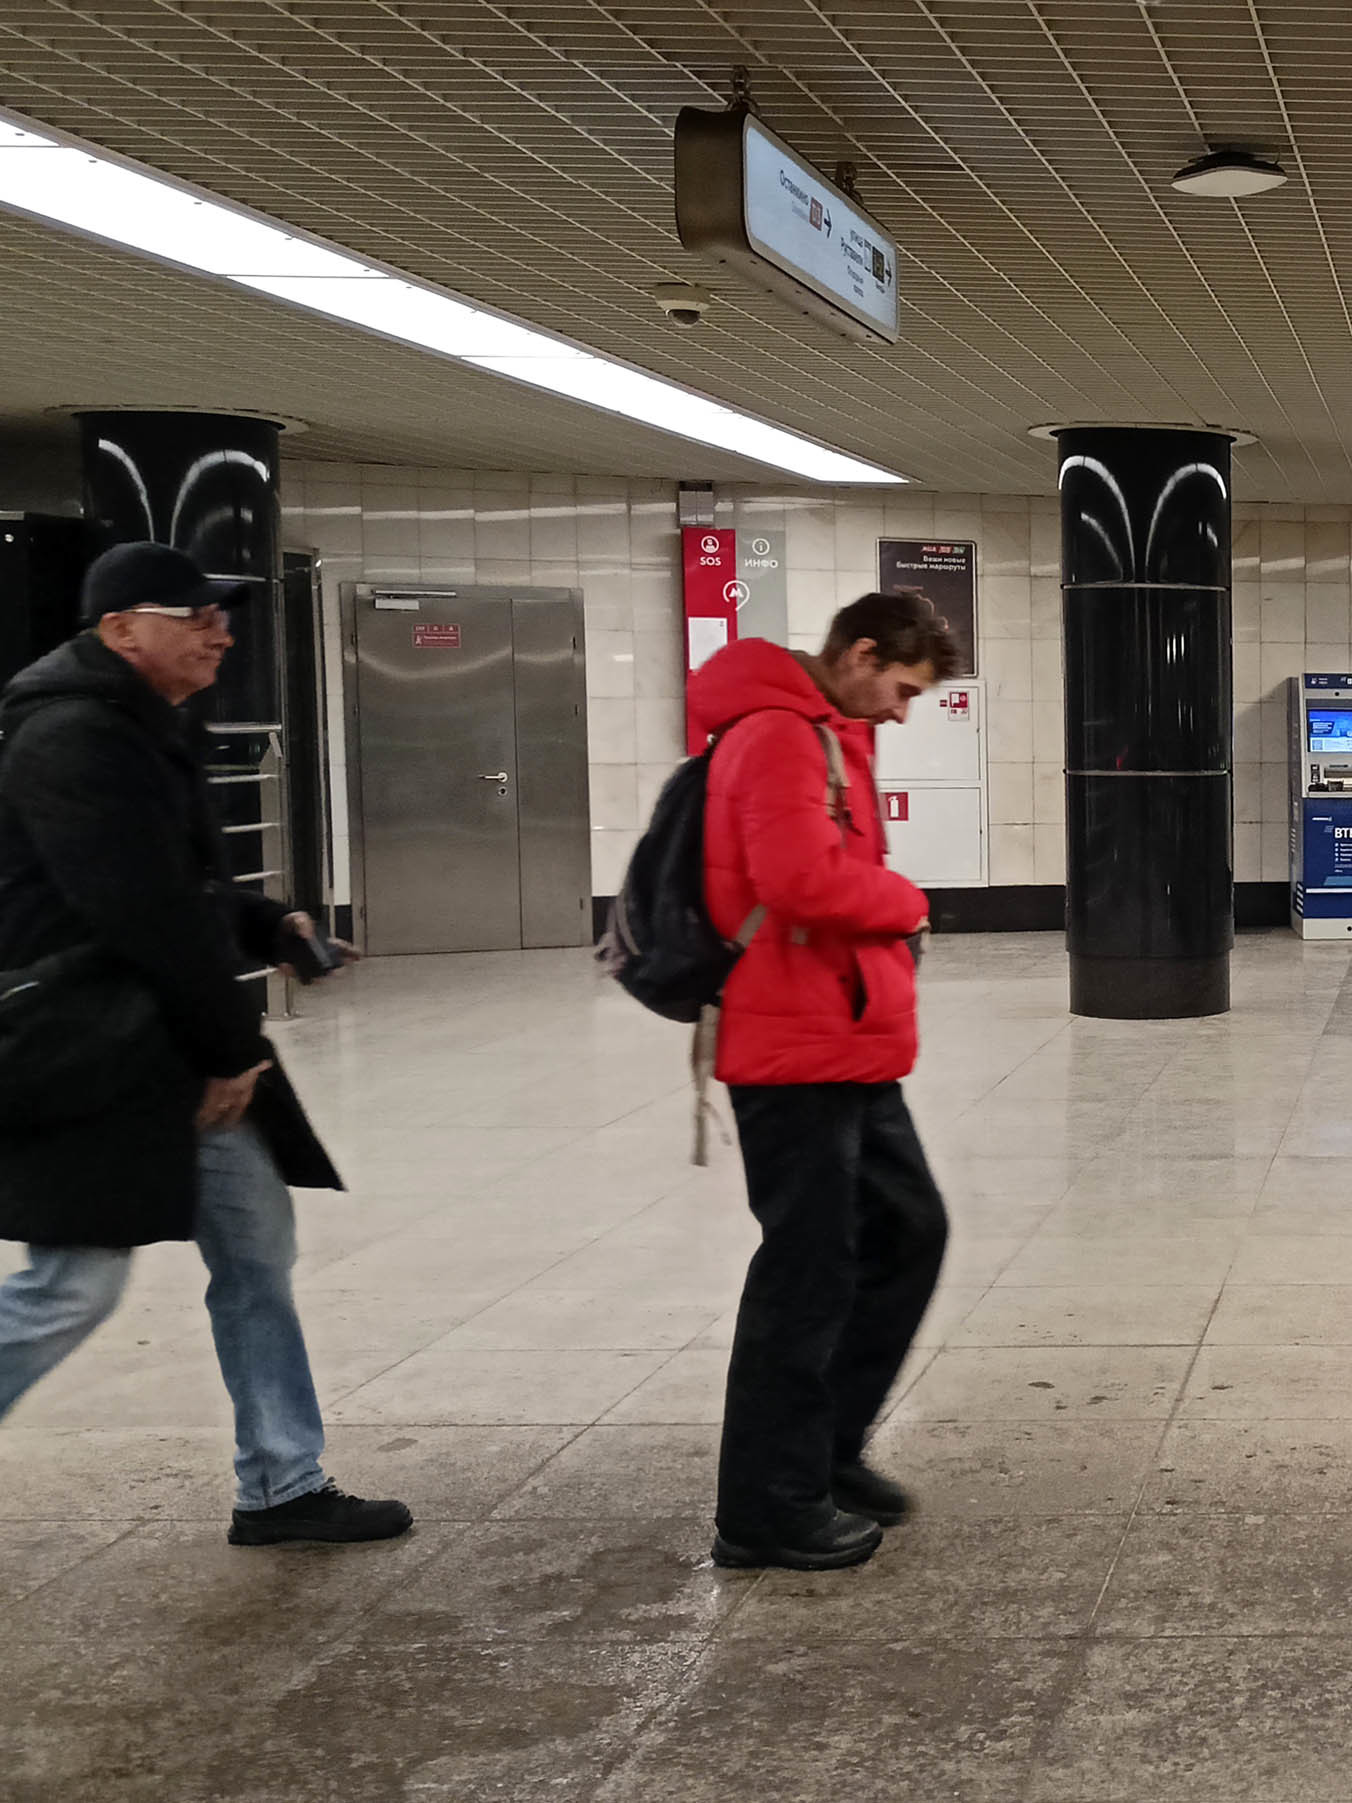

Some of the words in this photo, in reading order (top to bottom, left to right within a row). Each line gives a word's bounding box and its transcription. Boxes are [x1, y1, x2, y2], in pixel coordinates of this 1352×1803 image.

[700, 556, 722, 566] SOS
[744, 559, 778, 569] ИНФО
[929, 563, 966, 572] маршруты
